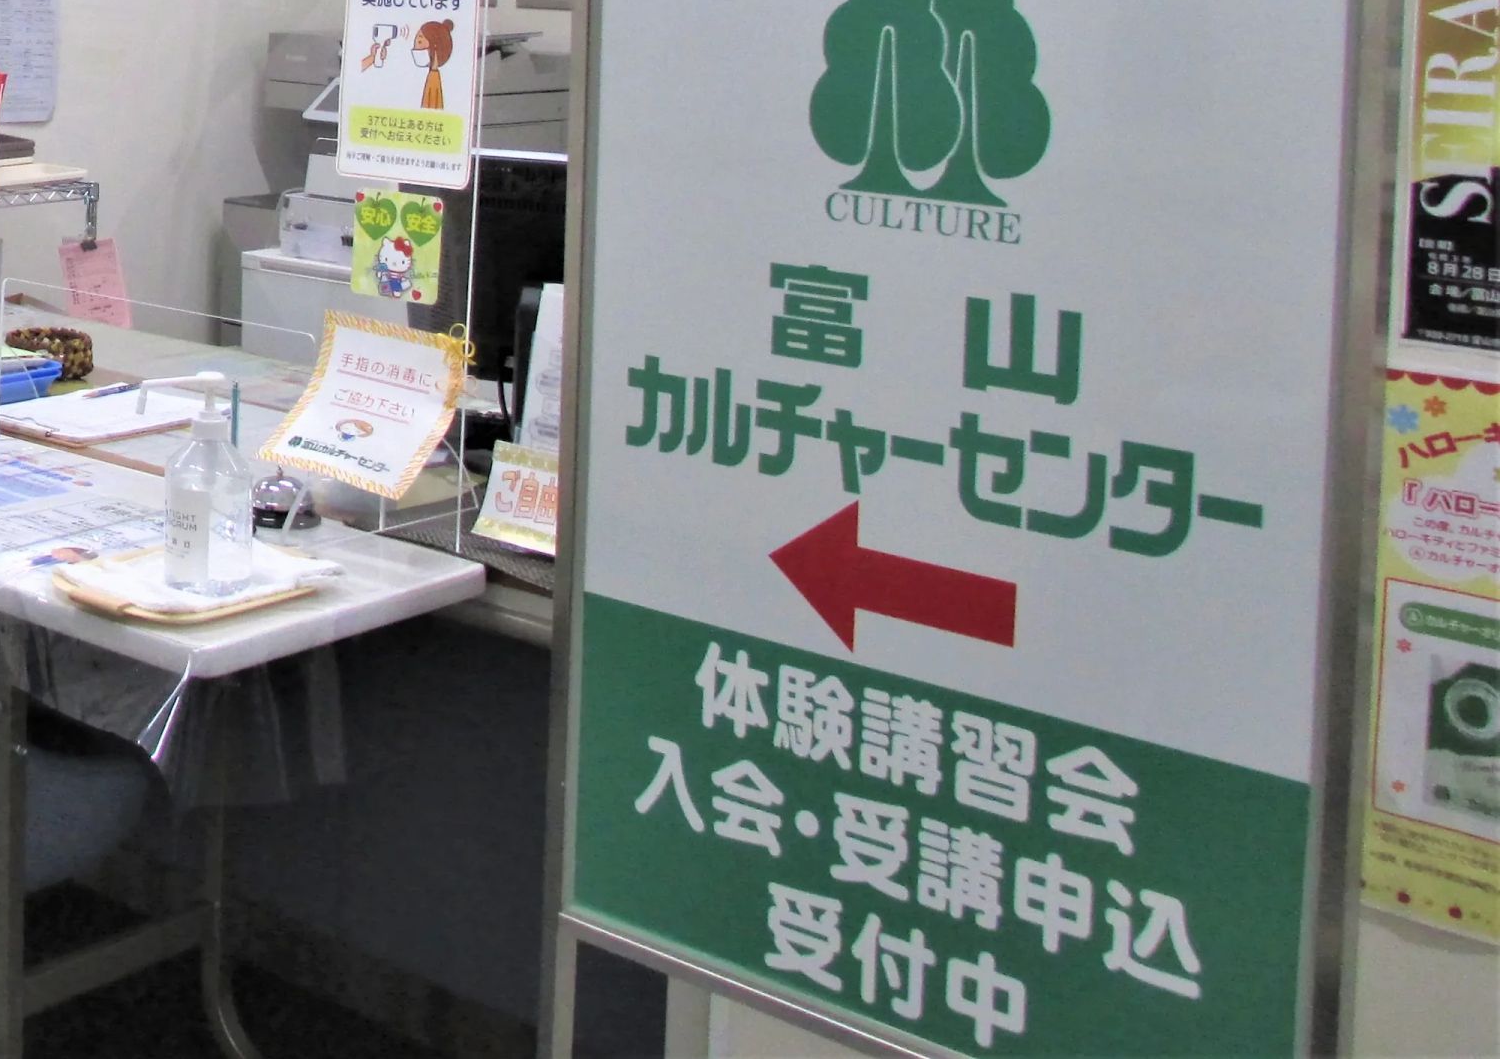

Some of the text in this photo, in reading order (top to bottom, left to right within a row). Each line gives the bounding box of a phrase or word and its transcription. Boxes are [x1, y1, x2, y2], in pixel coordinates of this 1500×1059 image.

[359, 127, 452, 147] 受付へお伝えください
[361, 206, 392, 227] 安心
[406, 213, 438, 235] 安全
[824, 191, 1022, 245] CULTURE
[340, 352, 433, 389] 手指の消毒に
[333, 387, 416, 419] ご協力下さい
[300, 439, 391, 474] 富山カルチャーセンター
[624, 353, 1264, 558] カルチャーセンター
[695, 641, 1139, 856] 体験講習会
[634, 735, 1201, 1000] 入会・受講申込
[763, 882, 1027, 1048] 受付中
